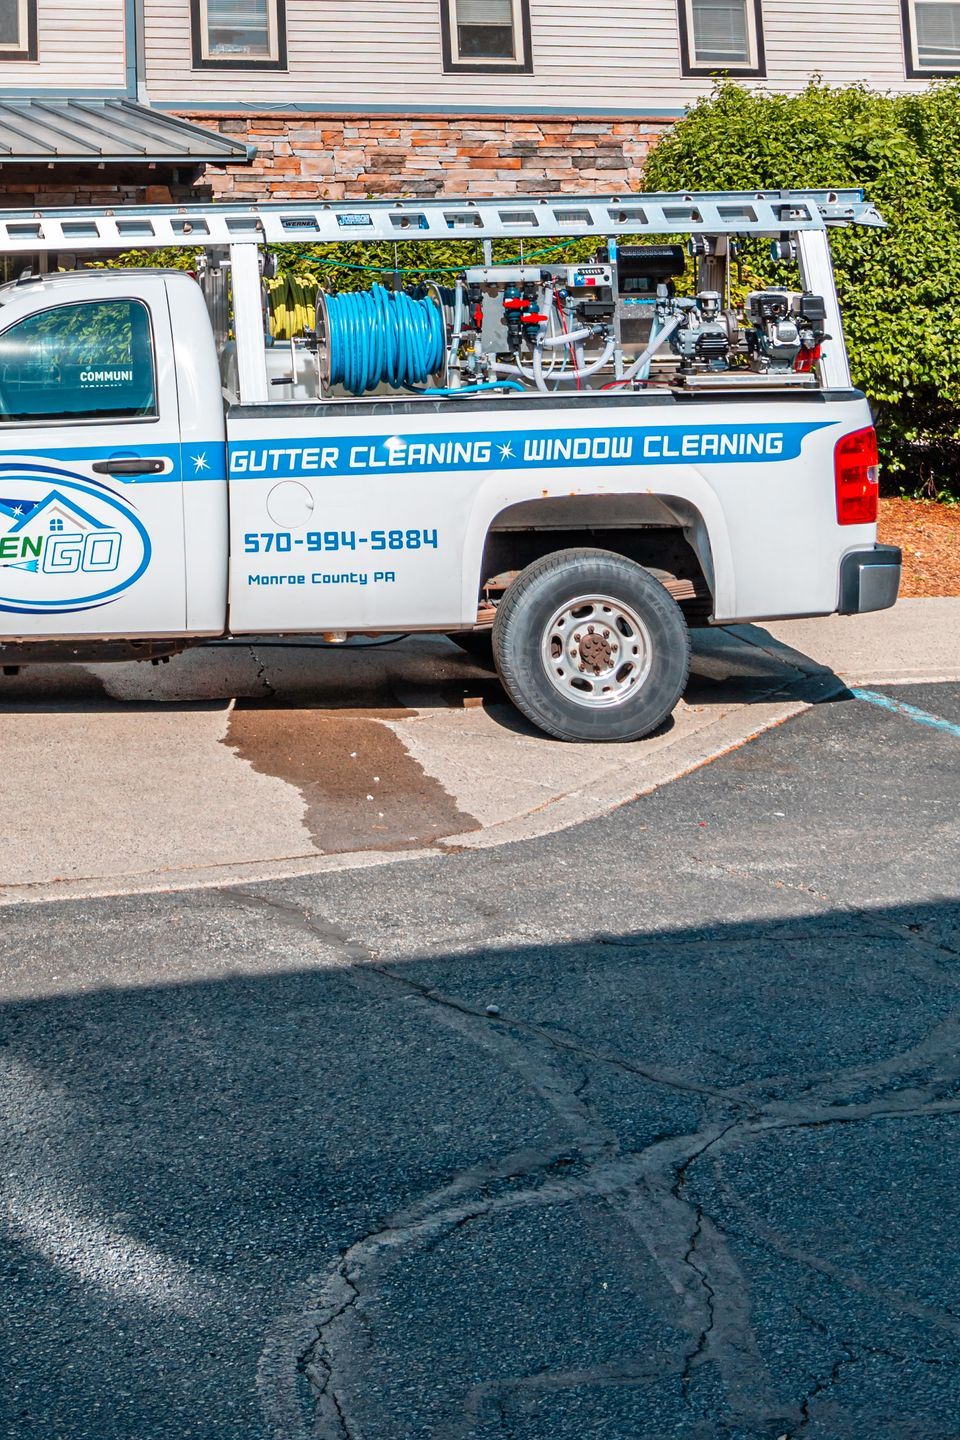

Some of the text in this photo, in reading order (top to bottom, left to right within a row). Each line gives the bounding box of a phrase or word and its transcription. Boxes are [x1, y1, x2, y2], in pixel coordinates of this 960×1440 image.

[80, 371, 133, 382] COMMUNI
[229, 441, 492, 472] GUTTER CLEANING
[523, 432, 783, 461] WINDOW CLEANING
[244, 529, 438, 553] 570-994-5884
[247, 571, 396, 586] Monroe County PA
